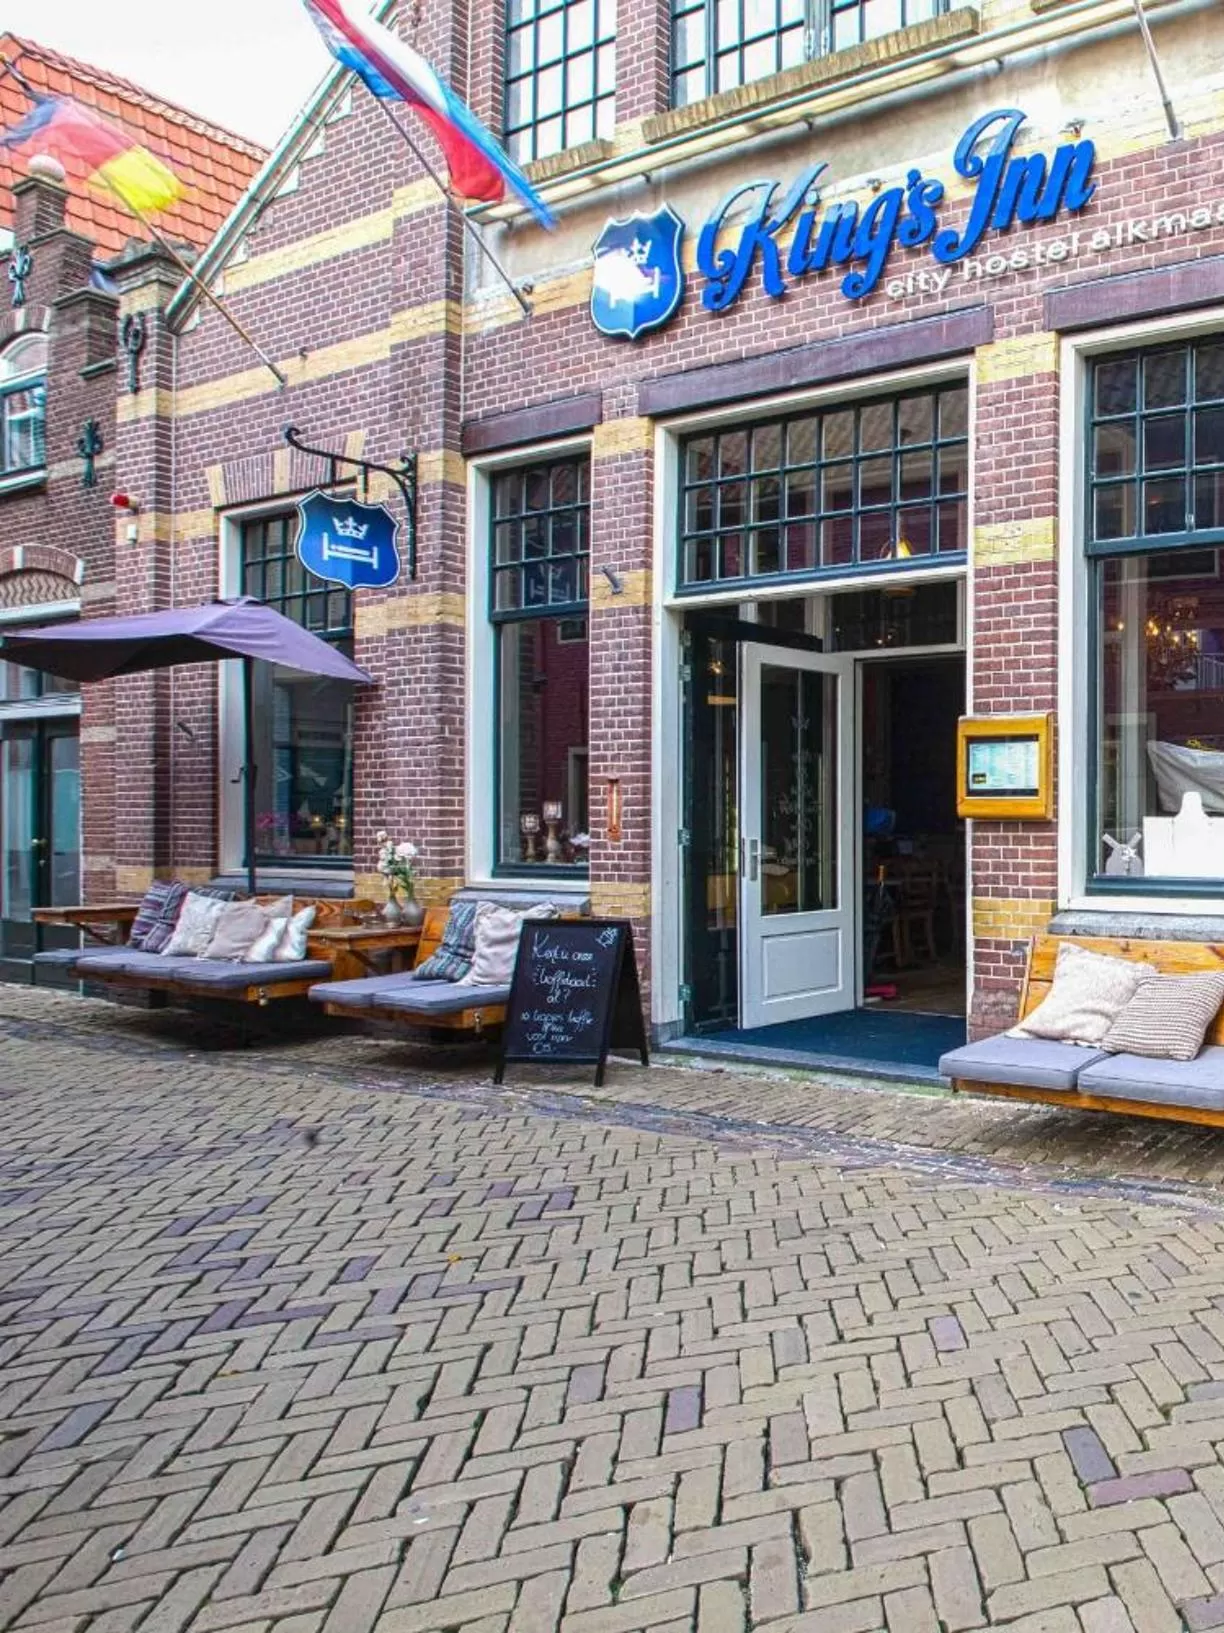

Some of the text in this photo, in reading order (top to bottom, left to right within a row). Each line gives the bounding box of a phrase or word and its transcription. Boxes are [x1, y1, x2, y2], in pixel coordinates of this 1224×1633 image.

[697, 109, 1097, 311] King's Inn
[885, 266, 953, 299] city
[962, 231, 1080, 283] hostel
